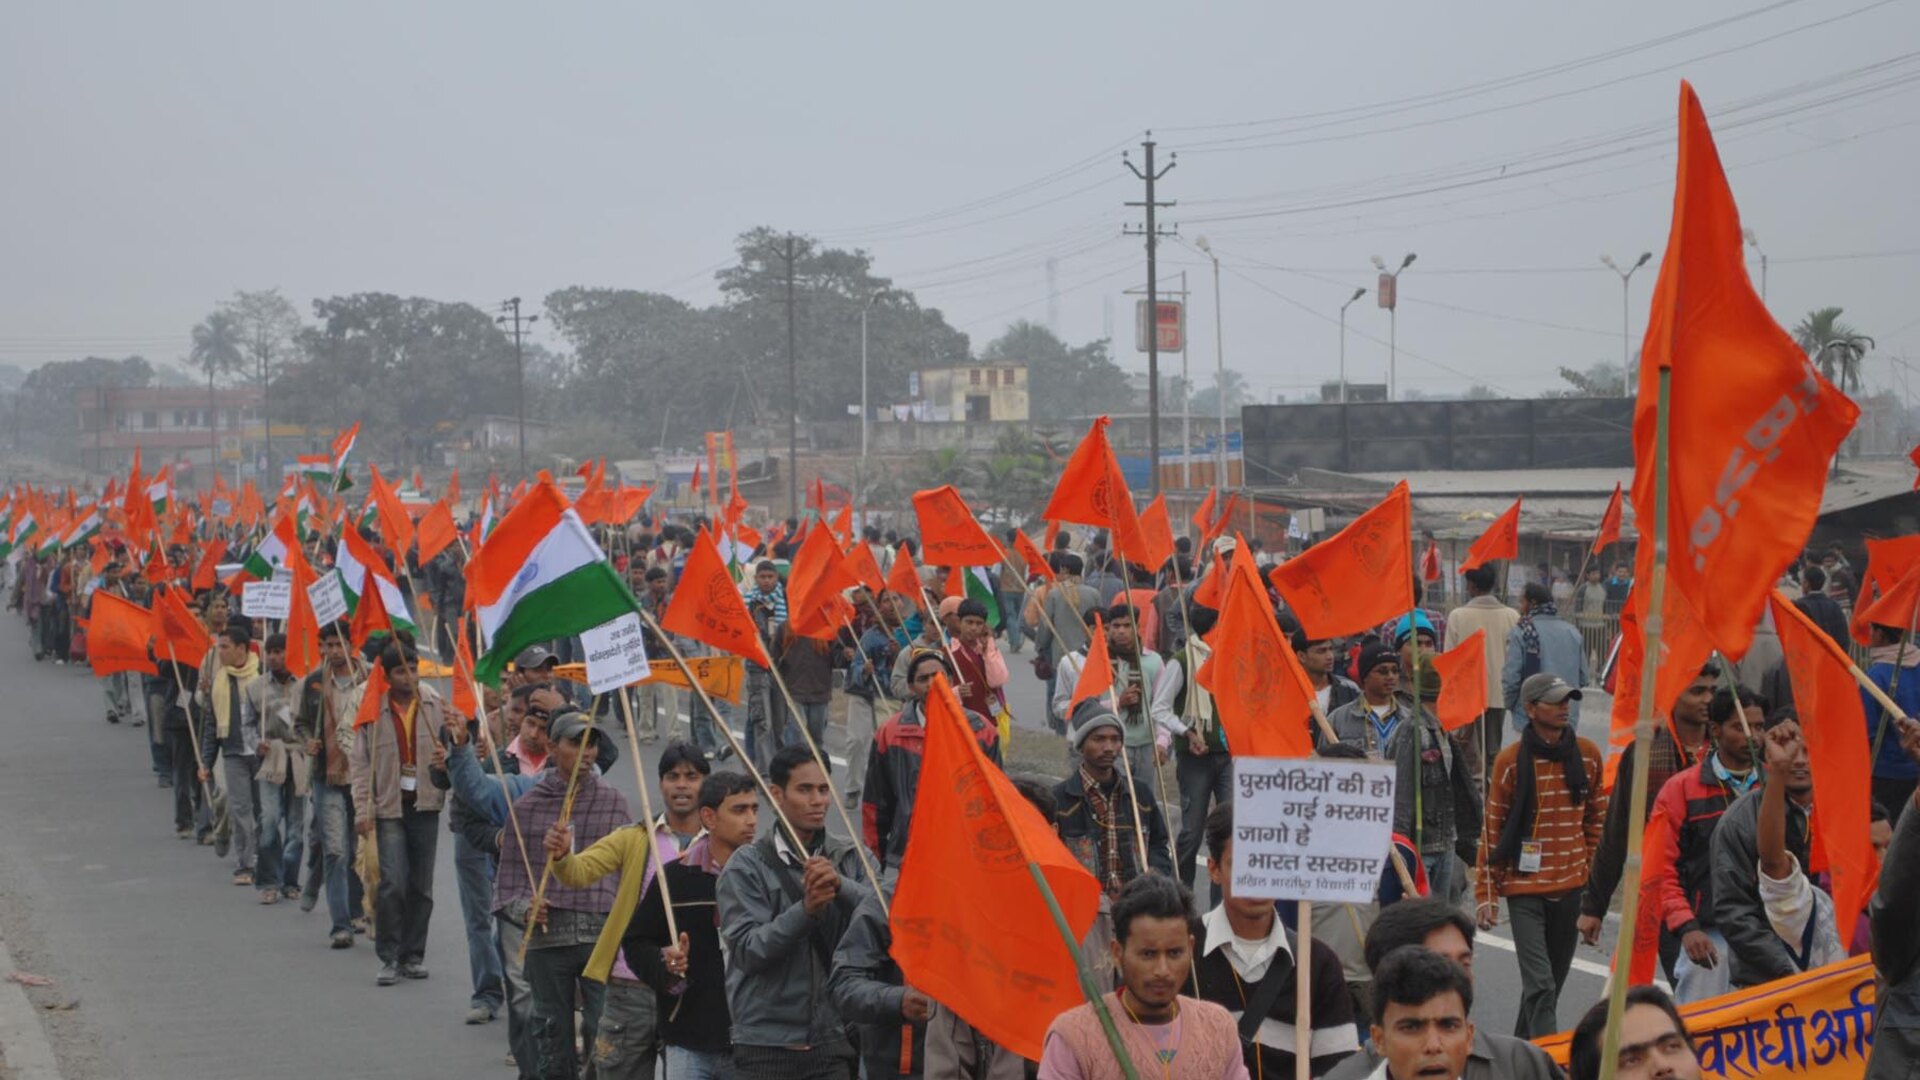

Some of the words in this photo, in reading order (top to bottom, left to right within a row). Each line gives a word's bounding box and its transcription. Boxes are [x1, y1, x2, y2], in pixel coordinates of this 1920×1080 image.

[1337, 771, 1364, 795] की
[1370, 775, 1392, 797] हो
[1283, 796, 1319, 821] गई
[1325, 803, 1391, 823] भरमार
[1237, 822, 1290, 843] जागो
[1295, 823, 1312, 846] हे
[1248, 853, 1300, 871] भारत
[1306, 856, 1380, 875] सरकार
